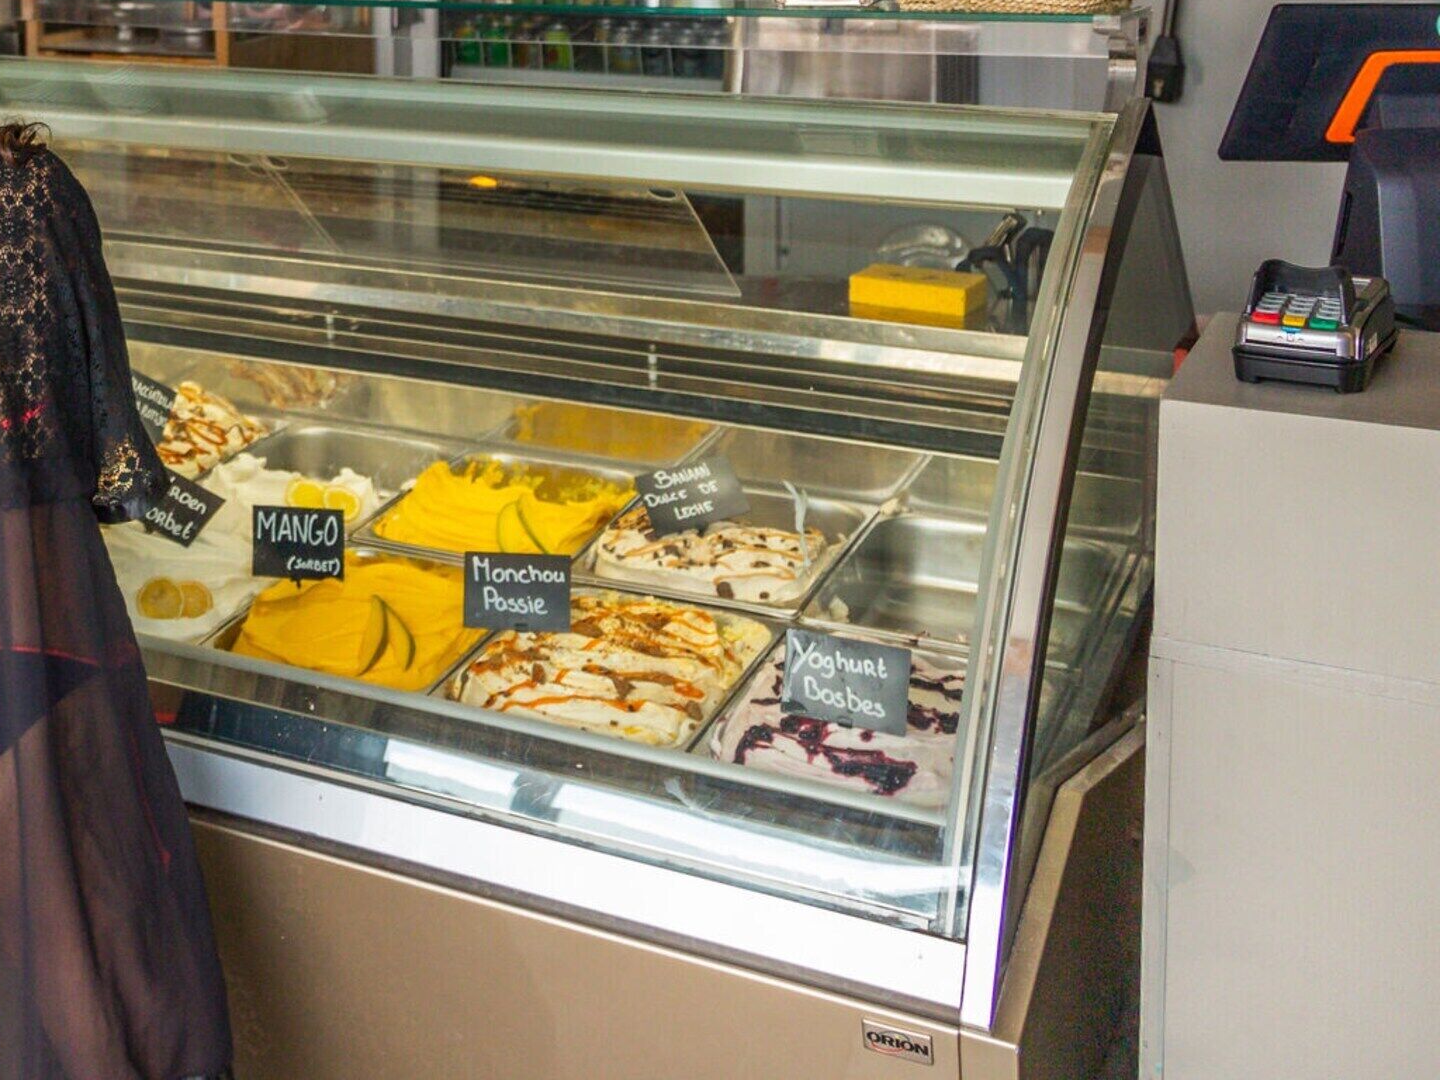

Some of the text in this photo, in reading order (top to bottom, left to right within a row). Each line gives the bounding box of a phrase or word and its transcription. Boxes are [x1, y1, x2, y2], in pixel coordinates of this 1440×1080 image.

[256, 510, 340, 547] MANGO
[471, 555, 567, 584] Monchou
[482, 585, 549, 615] Passie
[803, 675, 887, 718] Bosbes
[866, 1030, 930, 1057] ORION
